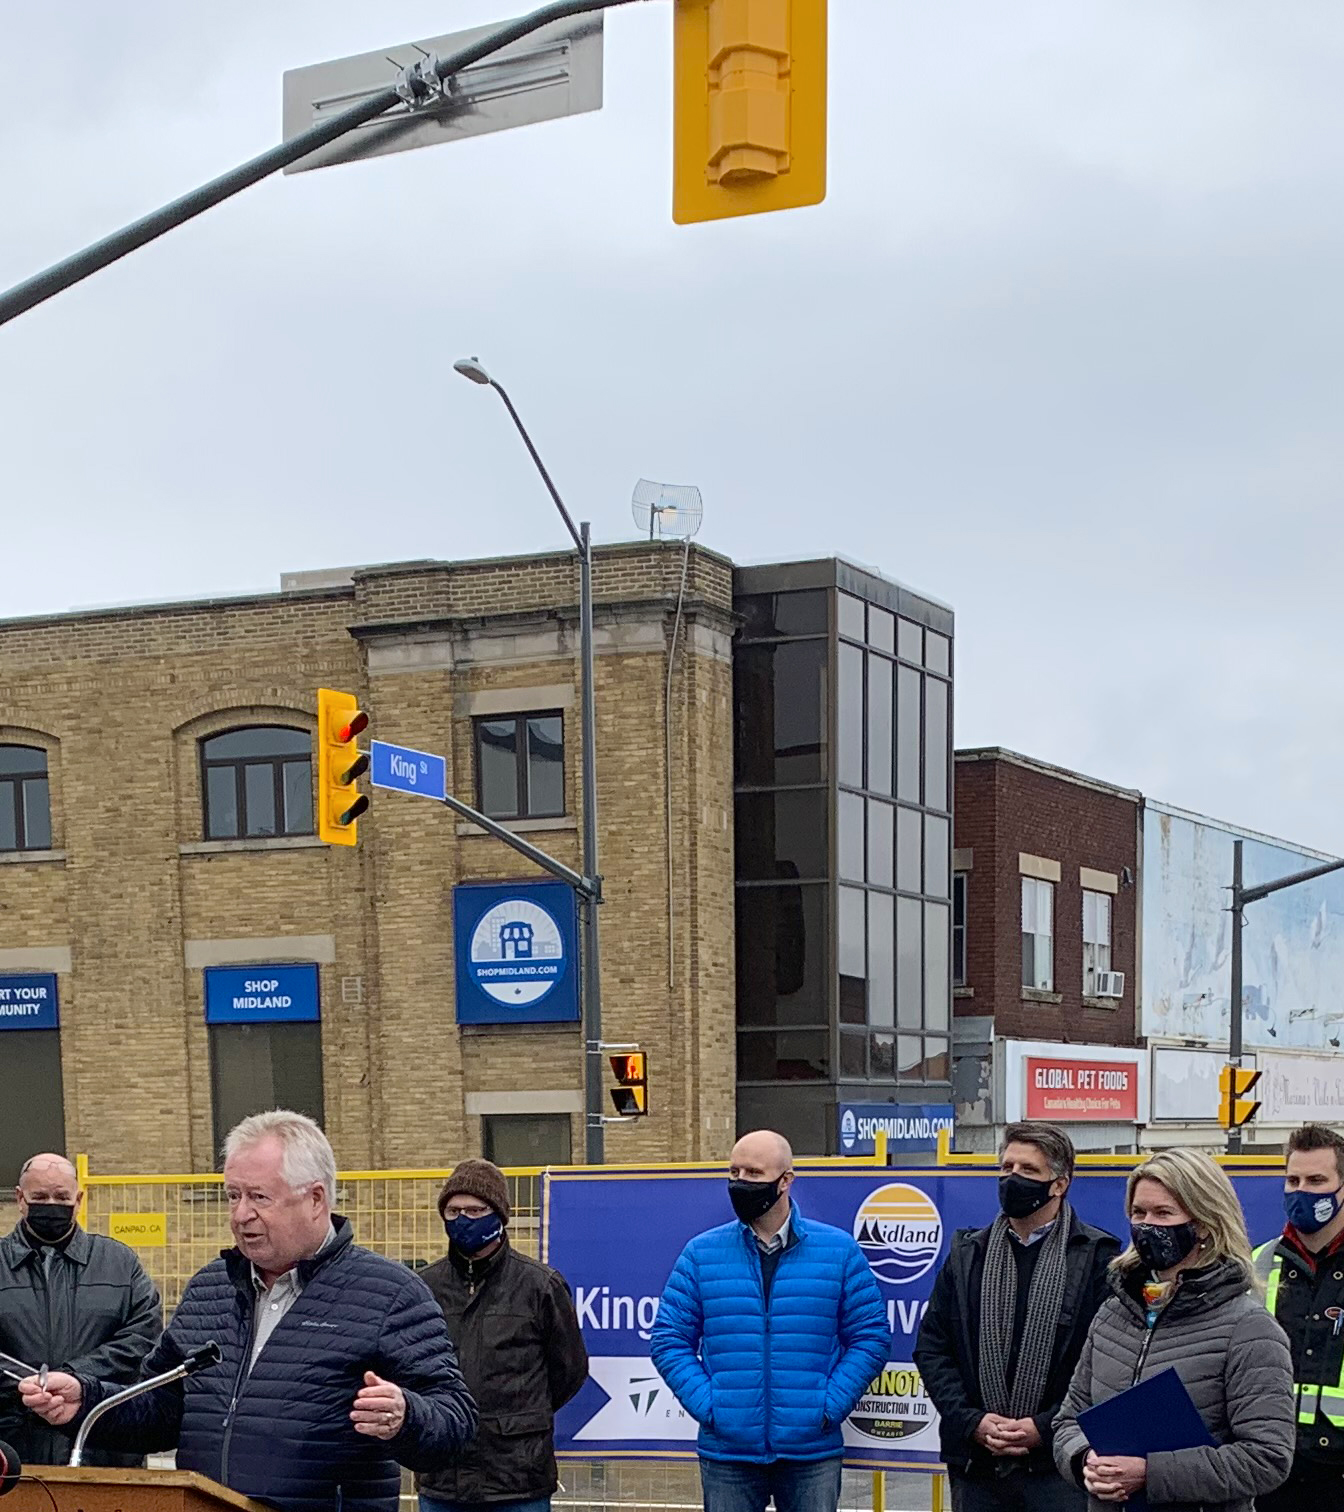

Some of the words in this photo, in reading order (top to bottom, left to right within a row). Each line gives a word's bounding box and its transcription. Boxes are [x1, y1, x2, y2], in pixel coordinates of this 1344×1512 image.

[390, 753, 417, 785] King
[476, 966, 558, 977] SHOPMIDLAND.COM
[244, 980, 279, 992] SHOP
[13, 987, 47, 1000] YOUR
[232, 996, 292, 1009] MIDLAND
[1035, 1068, 1075, 1089] GLOBAL
[1077, 1069, 1096, 1090] PET
[1098, 1070, 1128, 1091] FOODS
[575, 1286, 660, 1341] King
[855, 1400, 909, 1415] ONSTRUCTION
[913, 1403, 929, 1416] LTD.
[874, 1420, 904, 1429] BARRIE
